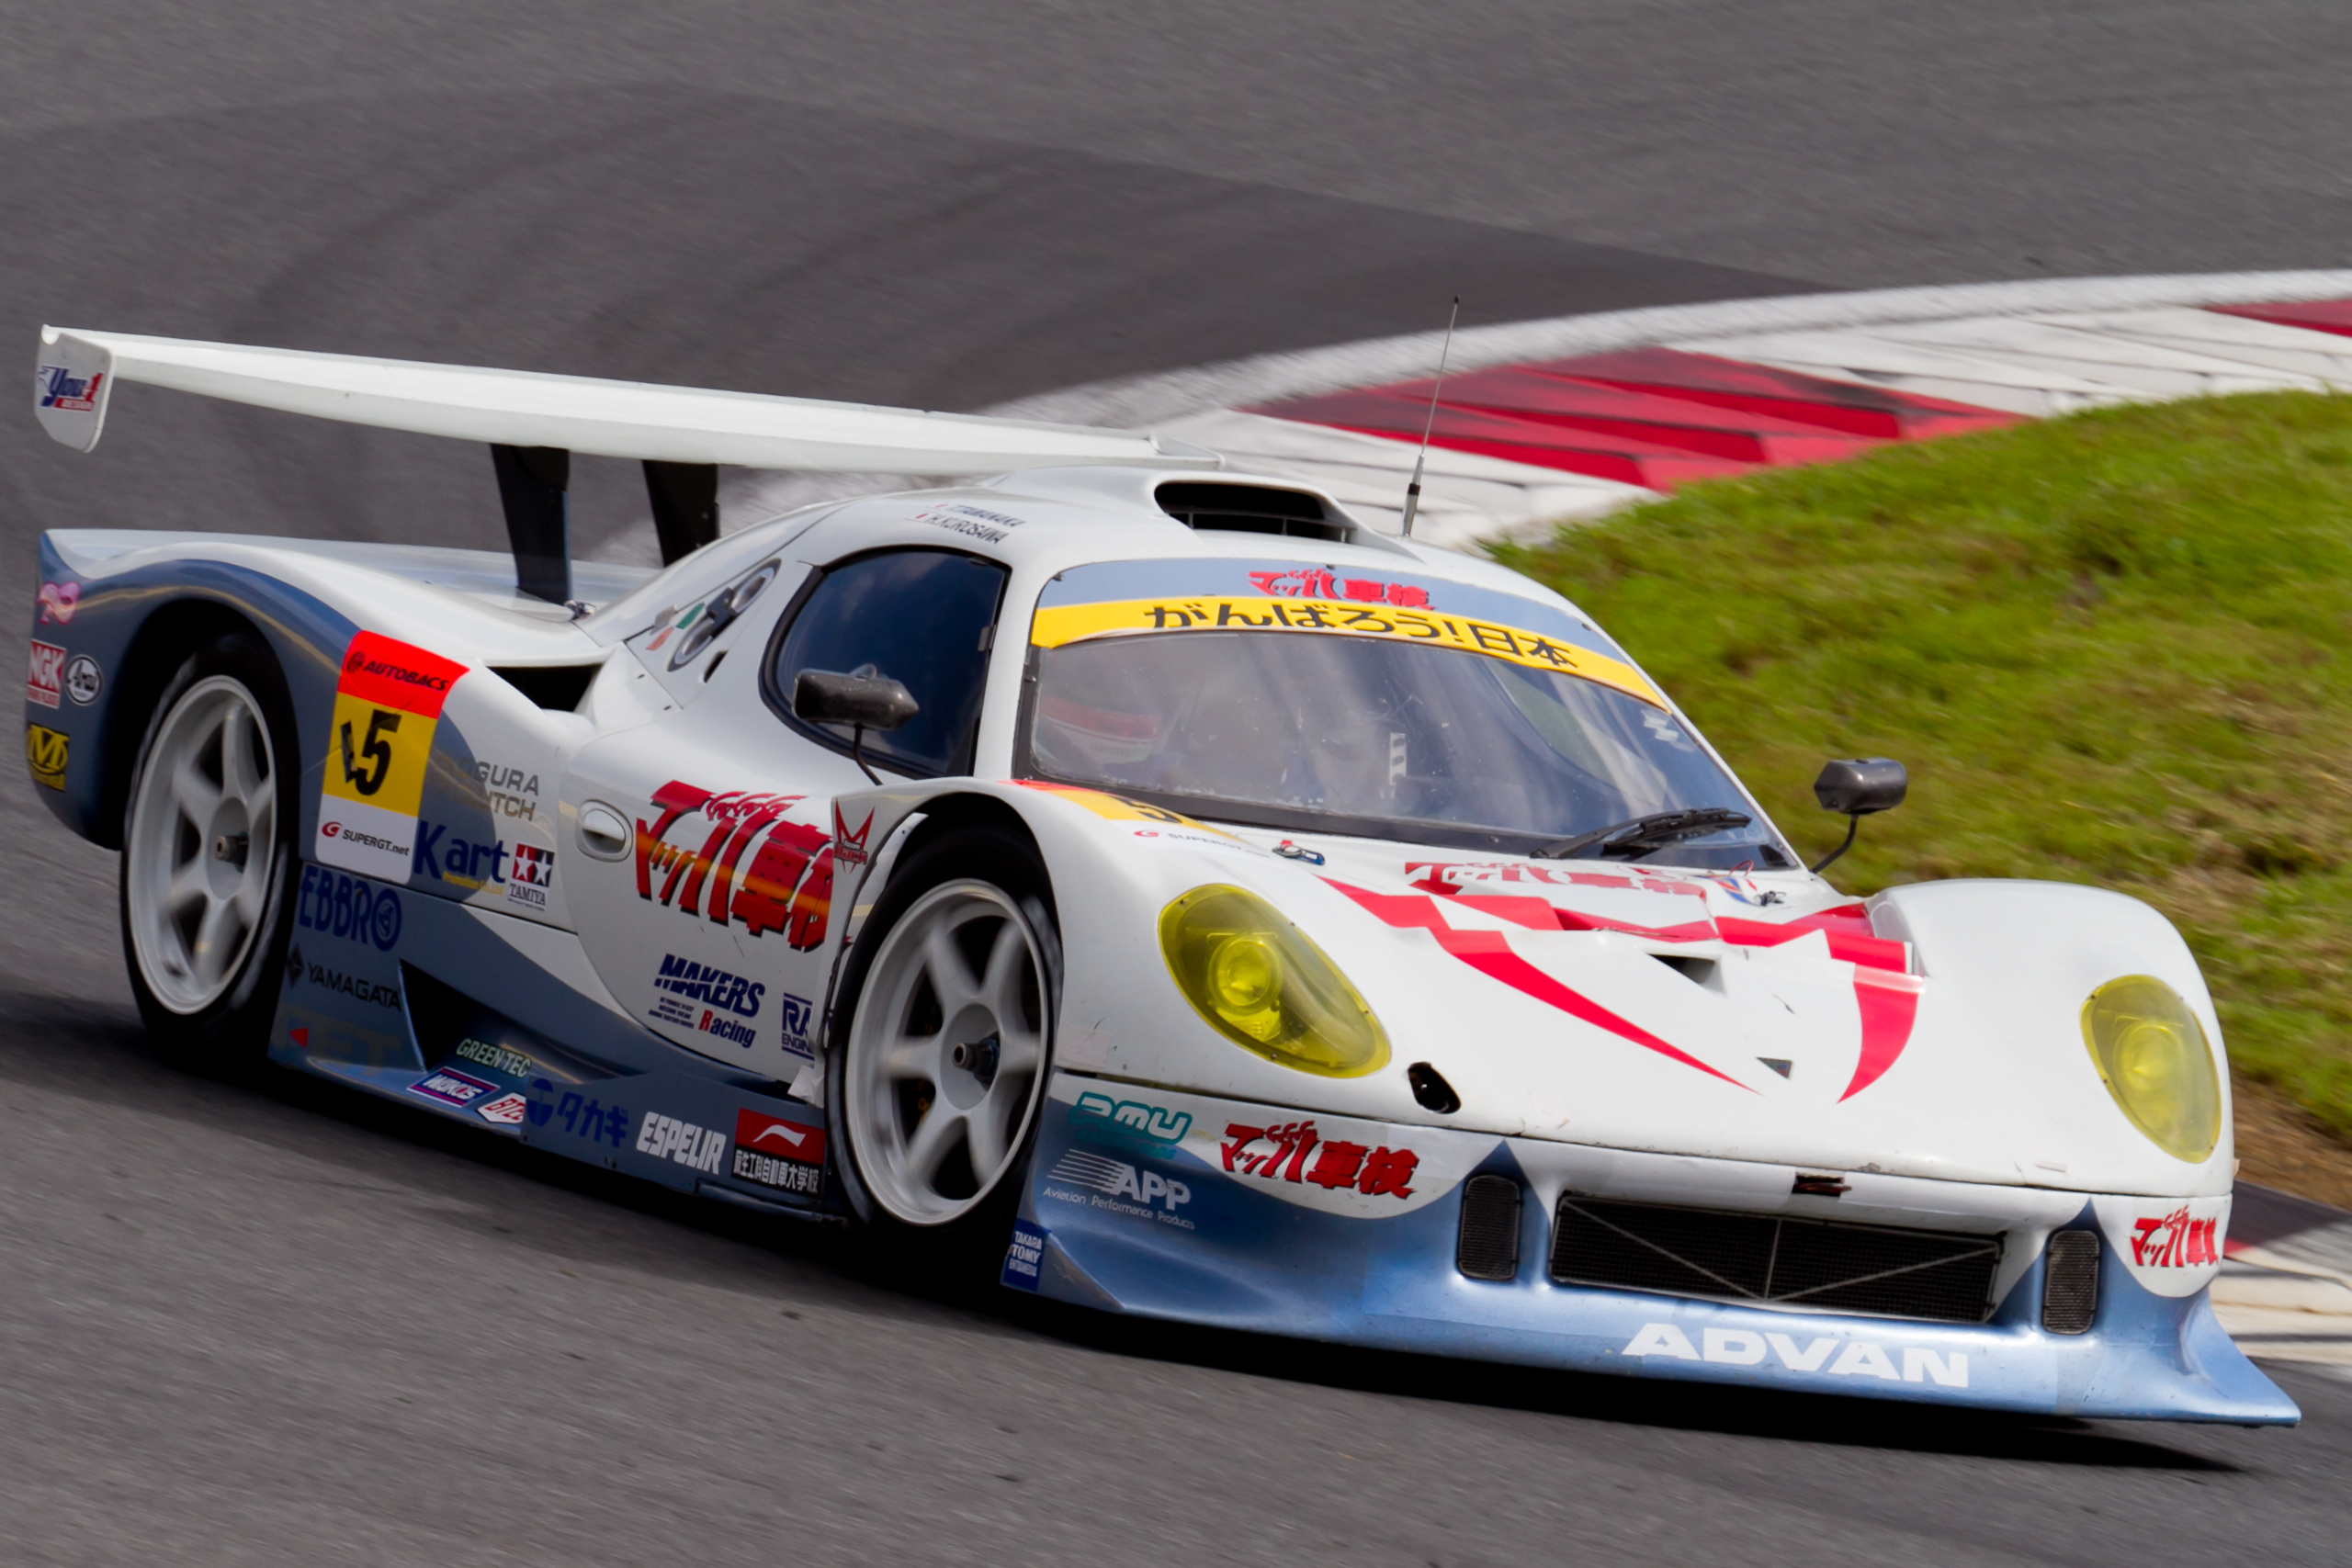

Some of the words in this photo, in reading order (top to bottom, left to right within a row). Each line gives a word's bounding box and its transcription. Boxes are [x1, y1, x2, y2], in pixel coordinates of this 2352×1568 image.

[29, 644, 64, 689] NGK
[364, 660, 450, 691] AUTOBACS
[342, 828, 411, 857] SUPERGT.net
[414, 820, 510, 884] Kart
[509, 883, 547, 907] TAMIYA
[307, 962, 401, 1011] YAMAGATA
[654, 953, 766, 1018] MAKERS
[698, 1009, 757, 1049] Racing
[557, 1090, 628, 1148] タカギ
[636, 1111, 727, 1175] ESPELIR
[1043, 1187, 1087, 1204] Aviation
[1091, 1195, 1154, 1219] Performance
[1158, 1210, 1195, 1231] Products
[1110, 1163, 1192, 1211] APP
[1012, 1244, 1042, 1265] TOMY
[1014, 1231, 1043, 1250] TAKARA
[1622, 1322, 1969, 1388] ADVAN
